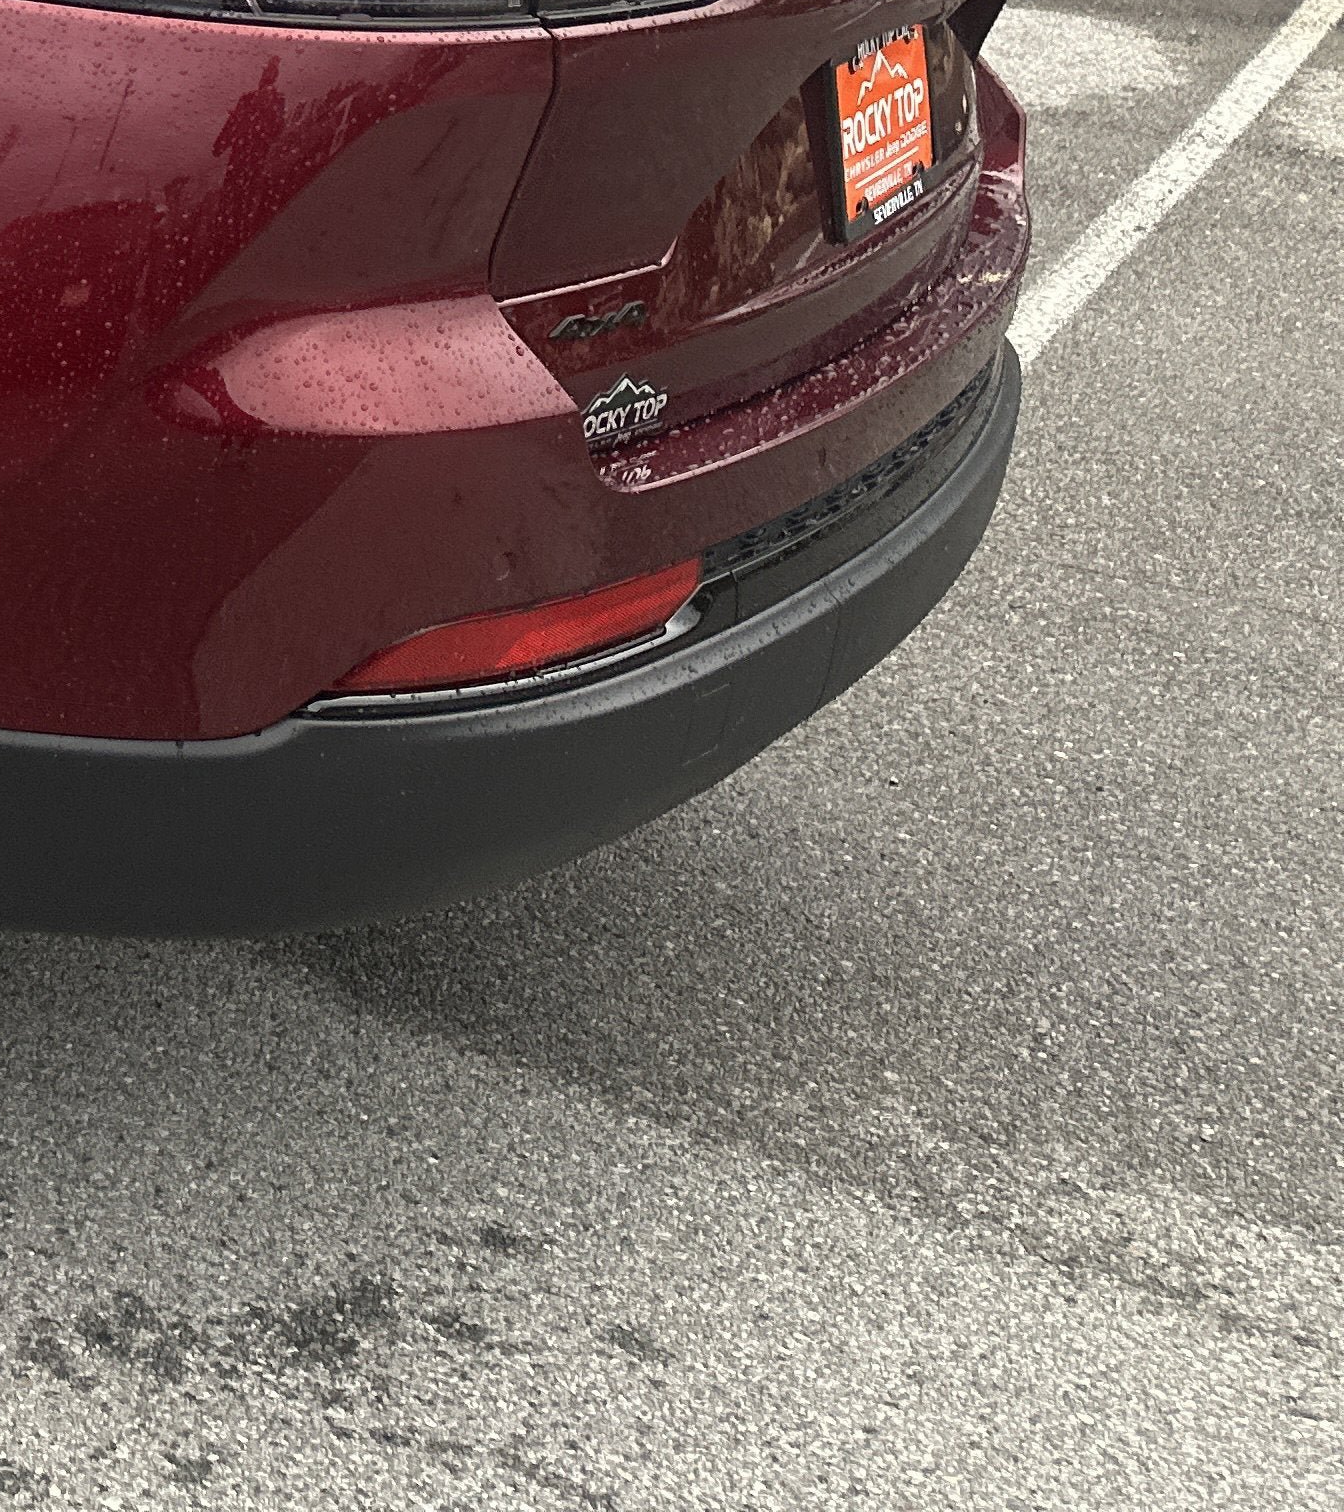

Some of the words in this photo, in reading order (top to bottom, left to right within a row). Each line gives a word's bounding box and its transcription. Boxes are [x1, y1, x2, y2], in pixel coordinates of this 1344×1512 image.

[842, 93, 892, 159] ROCKY
[894, 78, 924, 127] TOP
[844, 147, 885, 183] CHRYSLER
[914, 178, 924, 197] TN
[583, 403, 632, 438] OCKY
[634, 393, 668, 423] TOP
